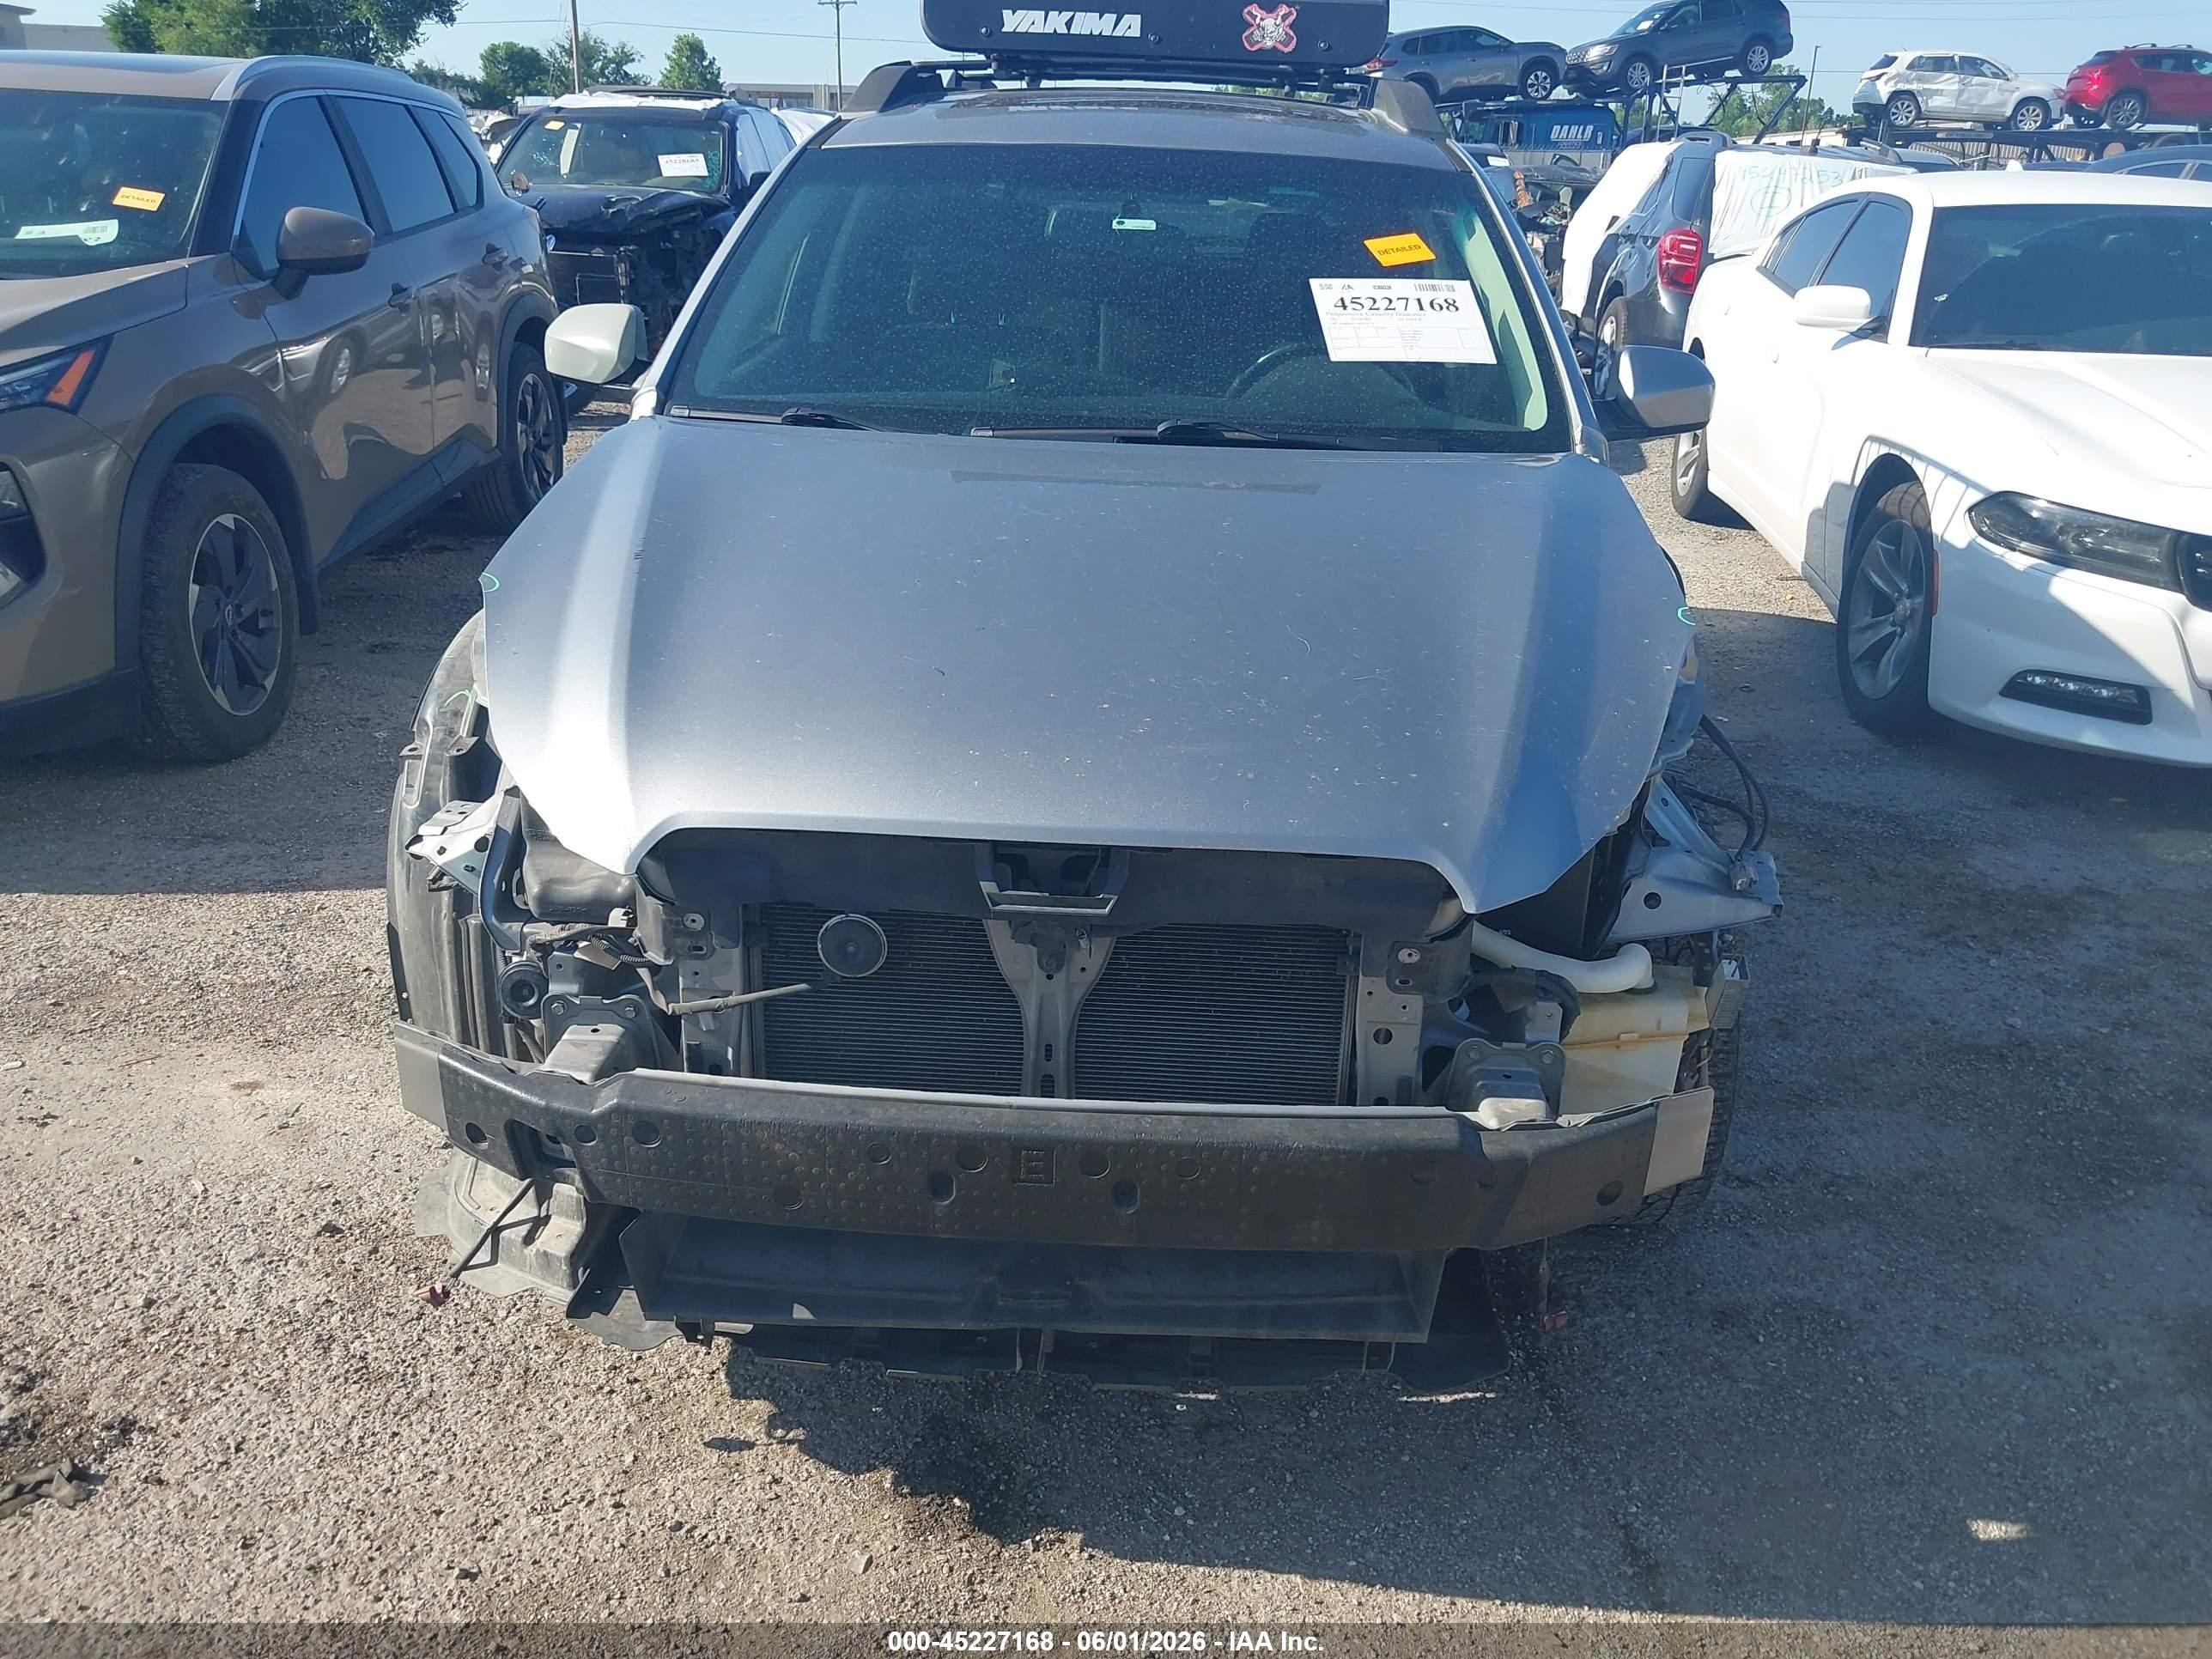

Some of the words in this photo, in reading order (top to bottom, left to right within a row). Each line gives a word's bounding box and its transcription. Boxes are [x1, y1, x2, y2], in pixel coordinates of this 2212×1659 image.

[1001, 9, 1141, 37] YAKIMA
[121, 194, 156, 204] DETAILED
[1376, 244, 1422, 256] DETAILED
[1334, 296, 1460, 313] 45227168
[1020, 1150, 1045, 1180] E
